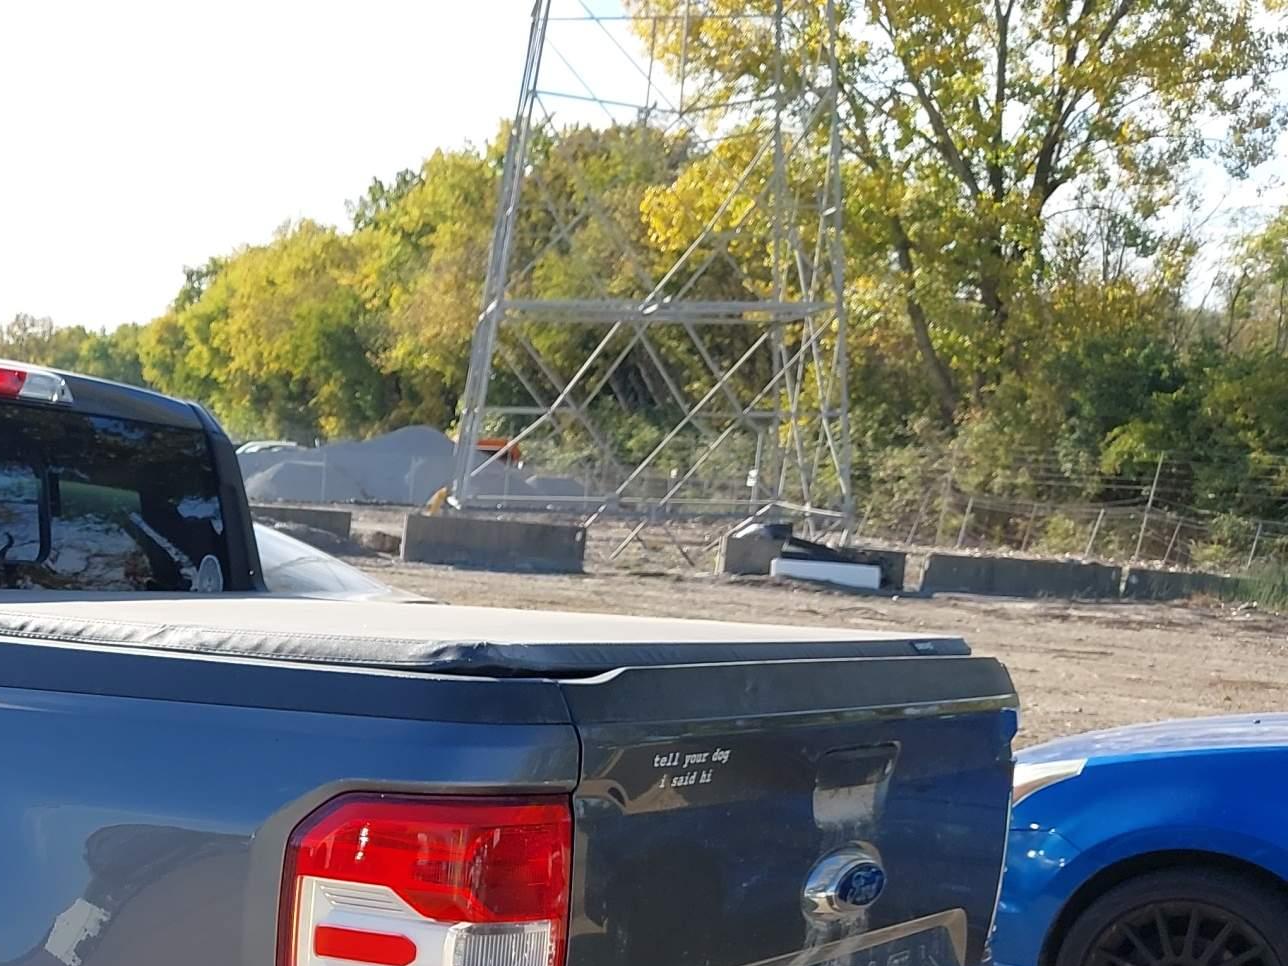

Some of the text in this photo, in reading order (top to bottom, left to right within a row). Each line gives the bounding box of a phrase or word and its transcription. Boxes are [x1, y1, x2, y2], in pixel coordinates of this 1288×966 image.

[653, 747, 731, 768] tell your dog
[671, 770, 697, 787] said
[699, 768, 713, 783] hi
